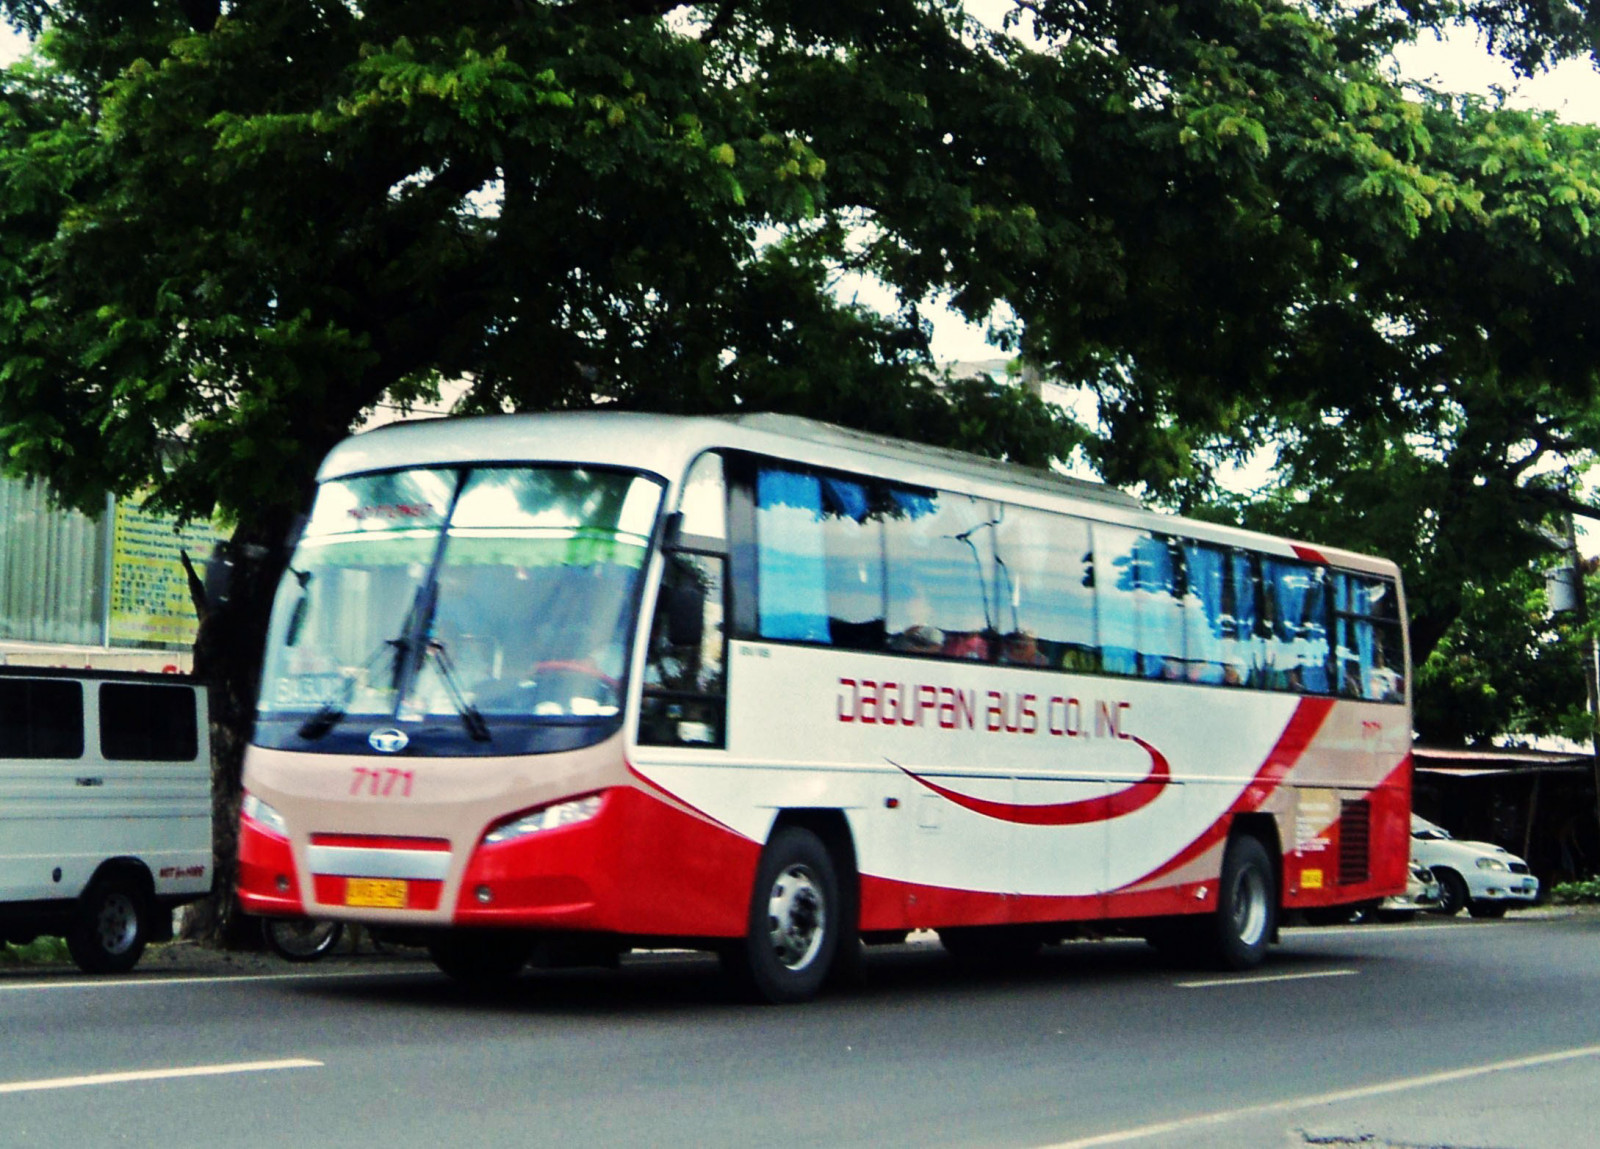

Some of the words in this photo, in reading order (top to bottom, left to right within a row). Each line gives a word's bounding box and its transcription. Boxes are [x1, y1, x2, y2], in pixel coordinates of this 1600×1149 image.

[838, 678, 975, 730] DAGUPAN
[986, 690, 1038, 734] BUS
[349, 767, 413, 798] 7171
